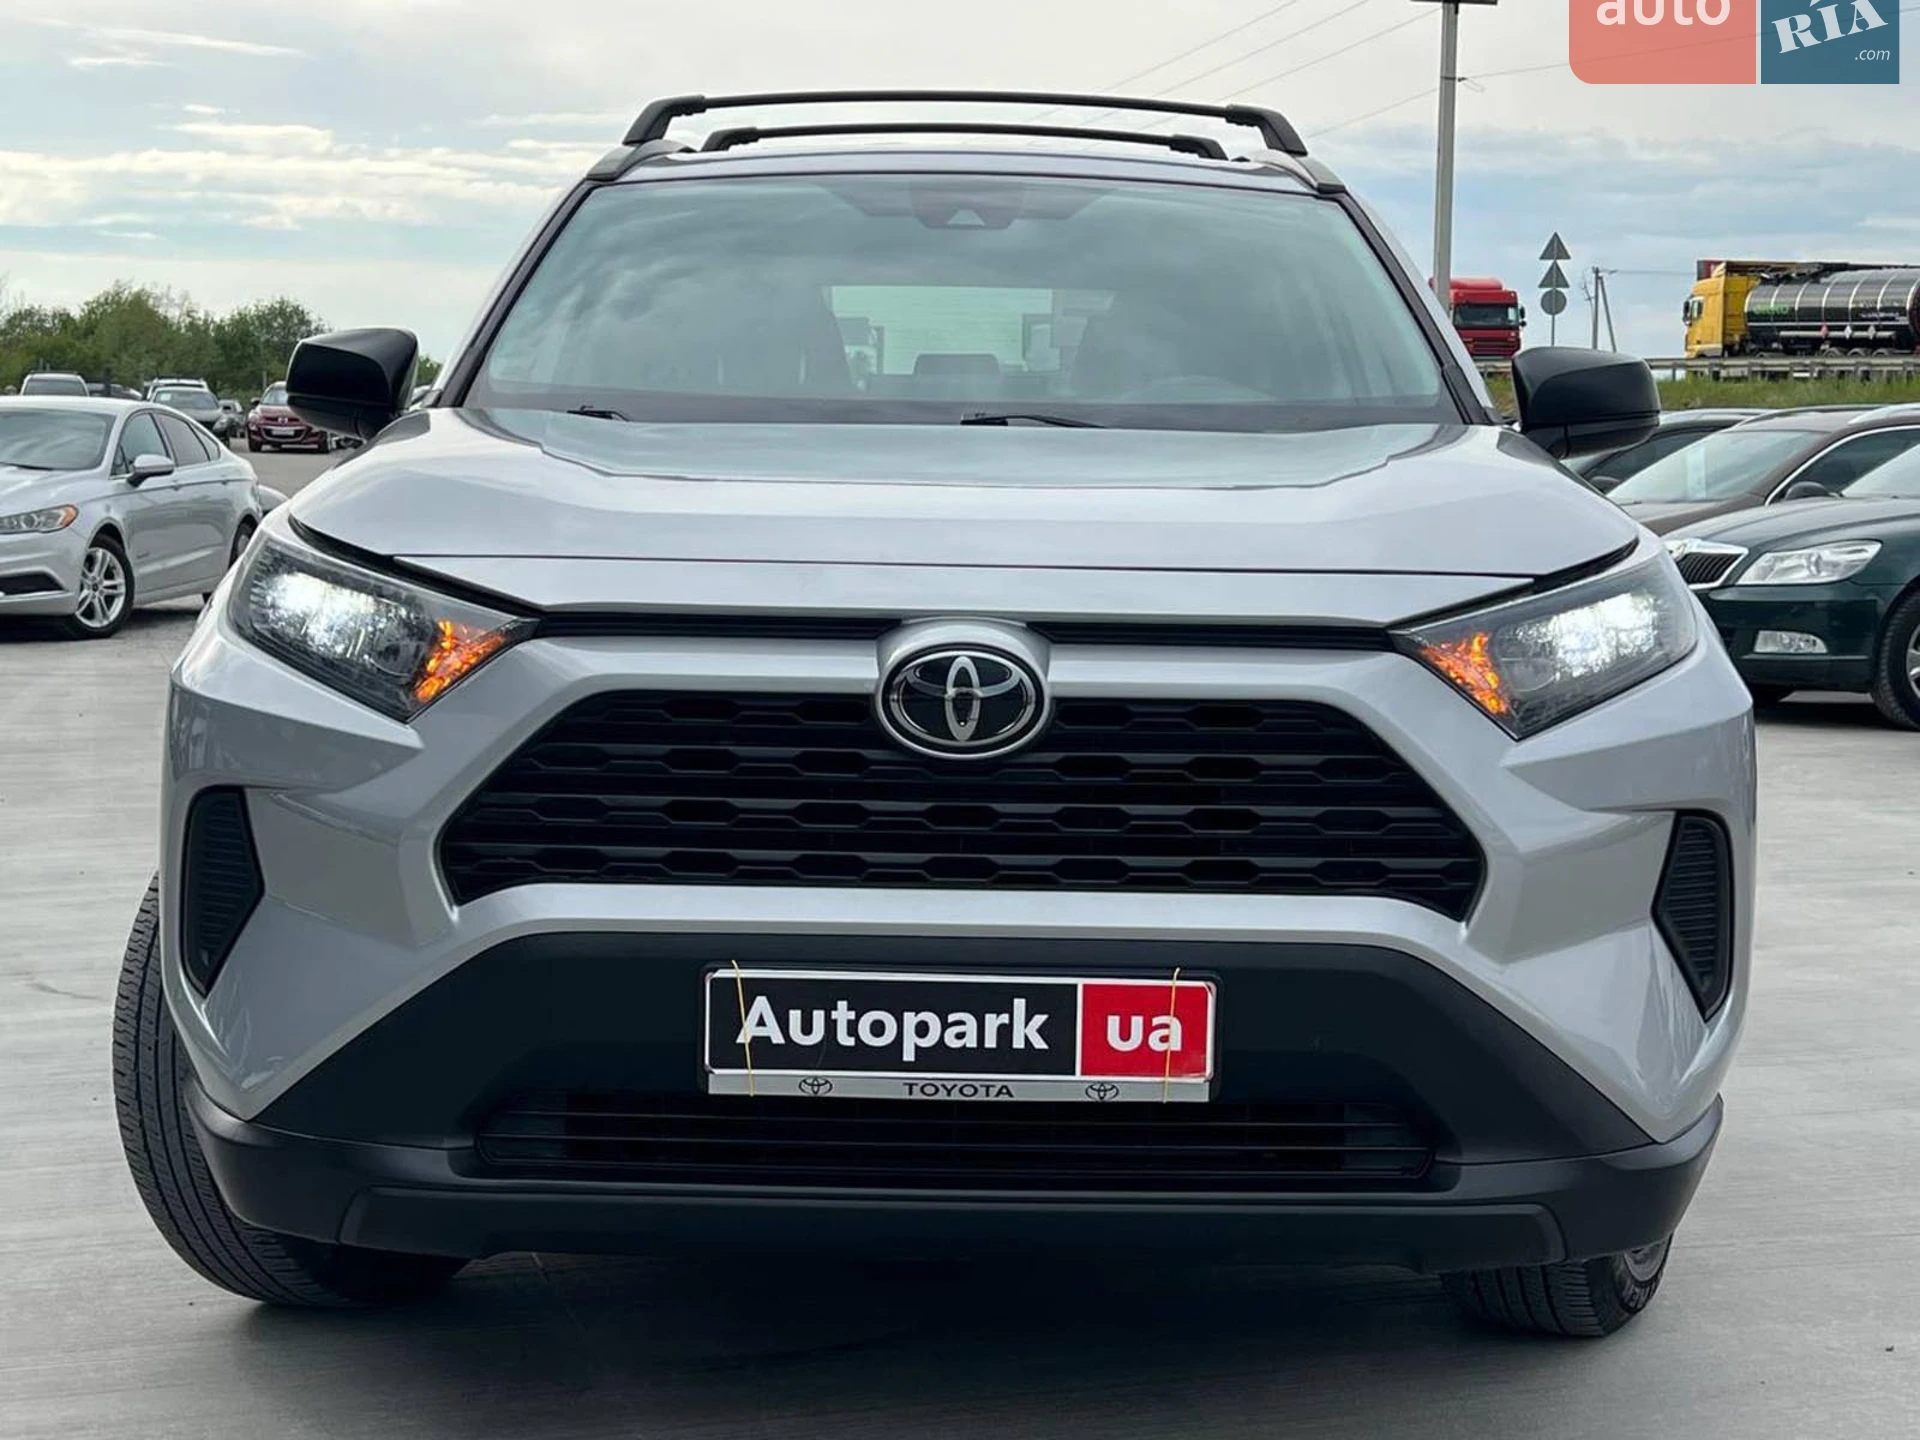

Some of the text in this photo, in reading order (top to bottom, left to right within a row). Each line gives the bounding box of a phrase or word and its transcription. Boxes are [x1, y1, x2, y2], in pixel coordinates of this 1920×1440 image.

[736, 995, 1182, 1062] Autopark ua
[902, 1081, 1015, 1099] TOYOTA
